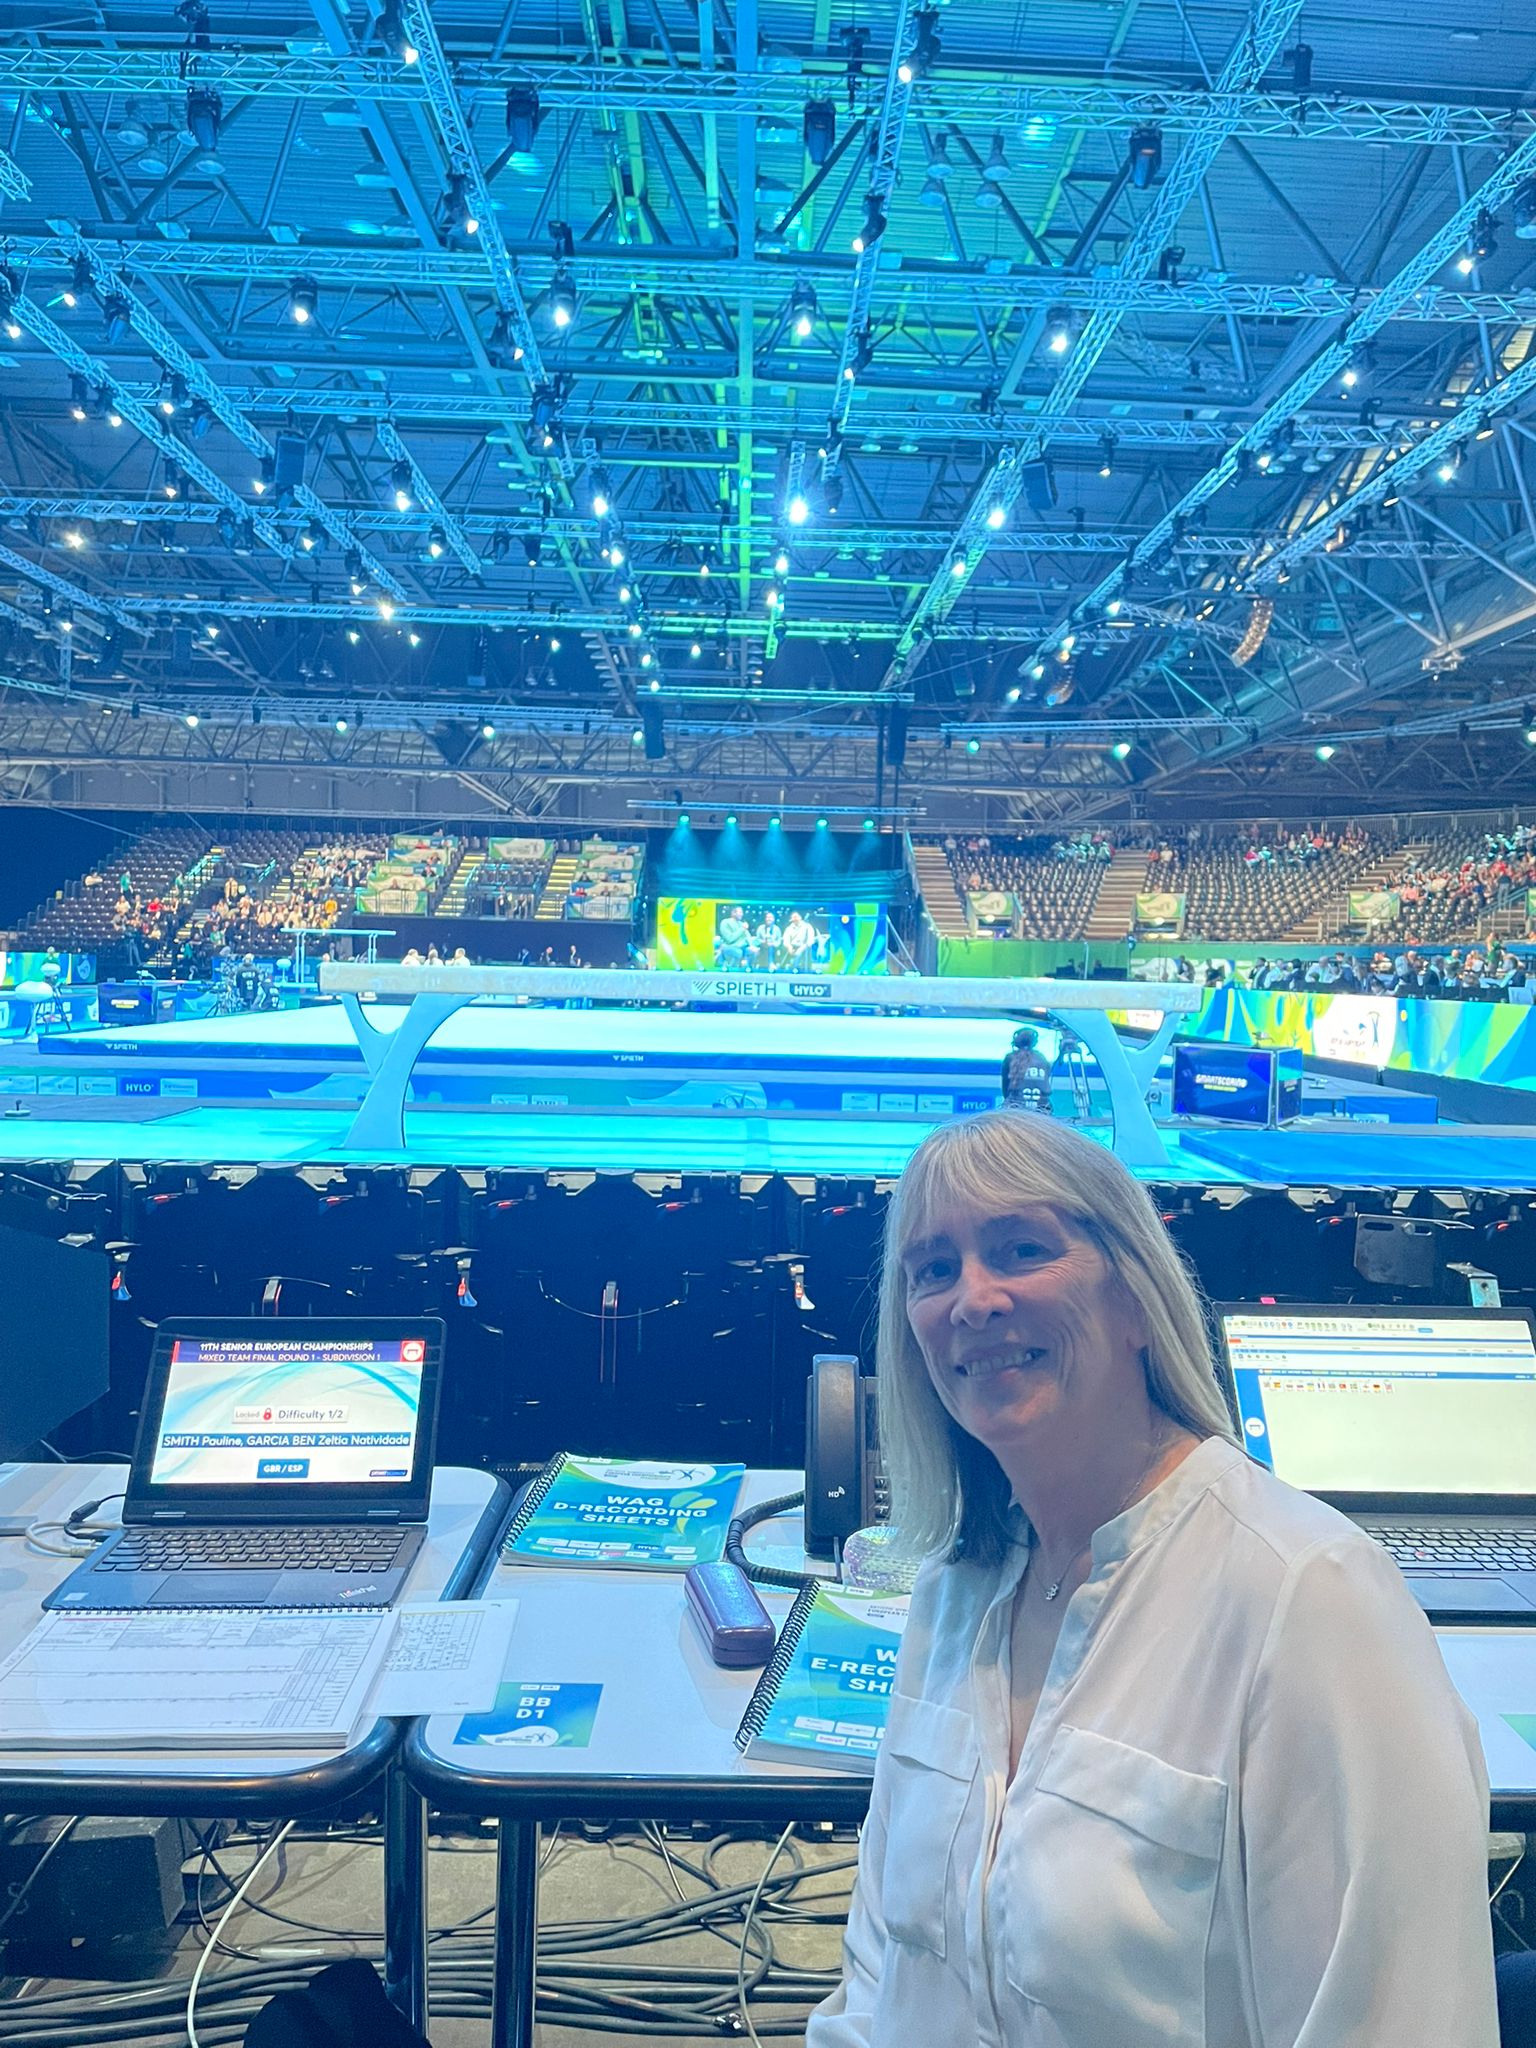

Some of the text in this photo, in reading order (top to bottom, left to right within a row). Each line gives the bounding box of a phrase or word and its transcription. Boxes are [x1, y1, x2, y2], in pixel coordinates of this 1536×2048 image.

[715, 981, 777, 996] SPIETH
[794, 985, 826, 996] HYLO
[125, 1083, 152, 1093] HYLO
[962, 1101, 988, 1110] HYLO
[200, 1342, 374, 1351] 11TH SENIOR EUROPEAN CHAMPIONSHIPS
[198, 1353, 226, 1362] MIXED
[228, 1353, 251, 1361] TEAM
[252, 1353, 275, 1361] FINAL
[278, 1353, 309, 1361] ROUND
[322, 1353, 375, 1361] SUBDIVISION
[278, 1409, 344, 1420] Difficulty 1/2
[163, 1434, 410, 1447] SMITH Pauline, GARCIA BEN Zeltia Natividade
[263, 1464, 282, 1473] GBR
[287, 1464, 303, 1473] ESP
[607, 1495, 664, 1506] WAG
[553, 1501, 708, 1518] D-RECORDING
[582, 1513, 670, 1527] SHEETS
[848, 1677, 893, 1695] SH
[519, 1696, 552, 1708] BB
[515, 1708, 545, 1720] D1
